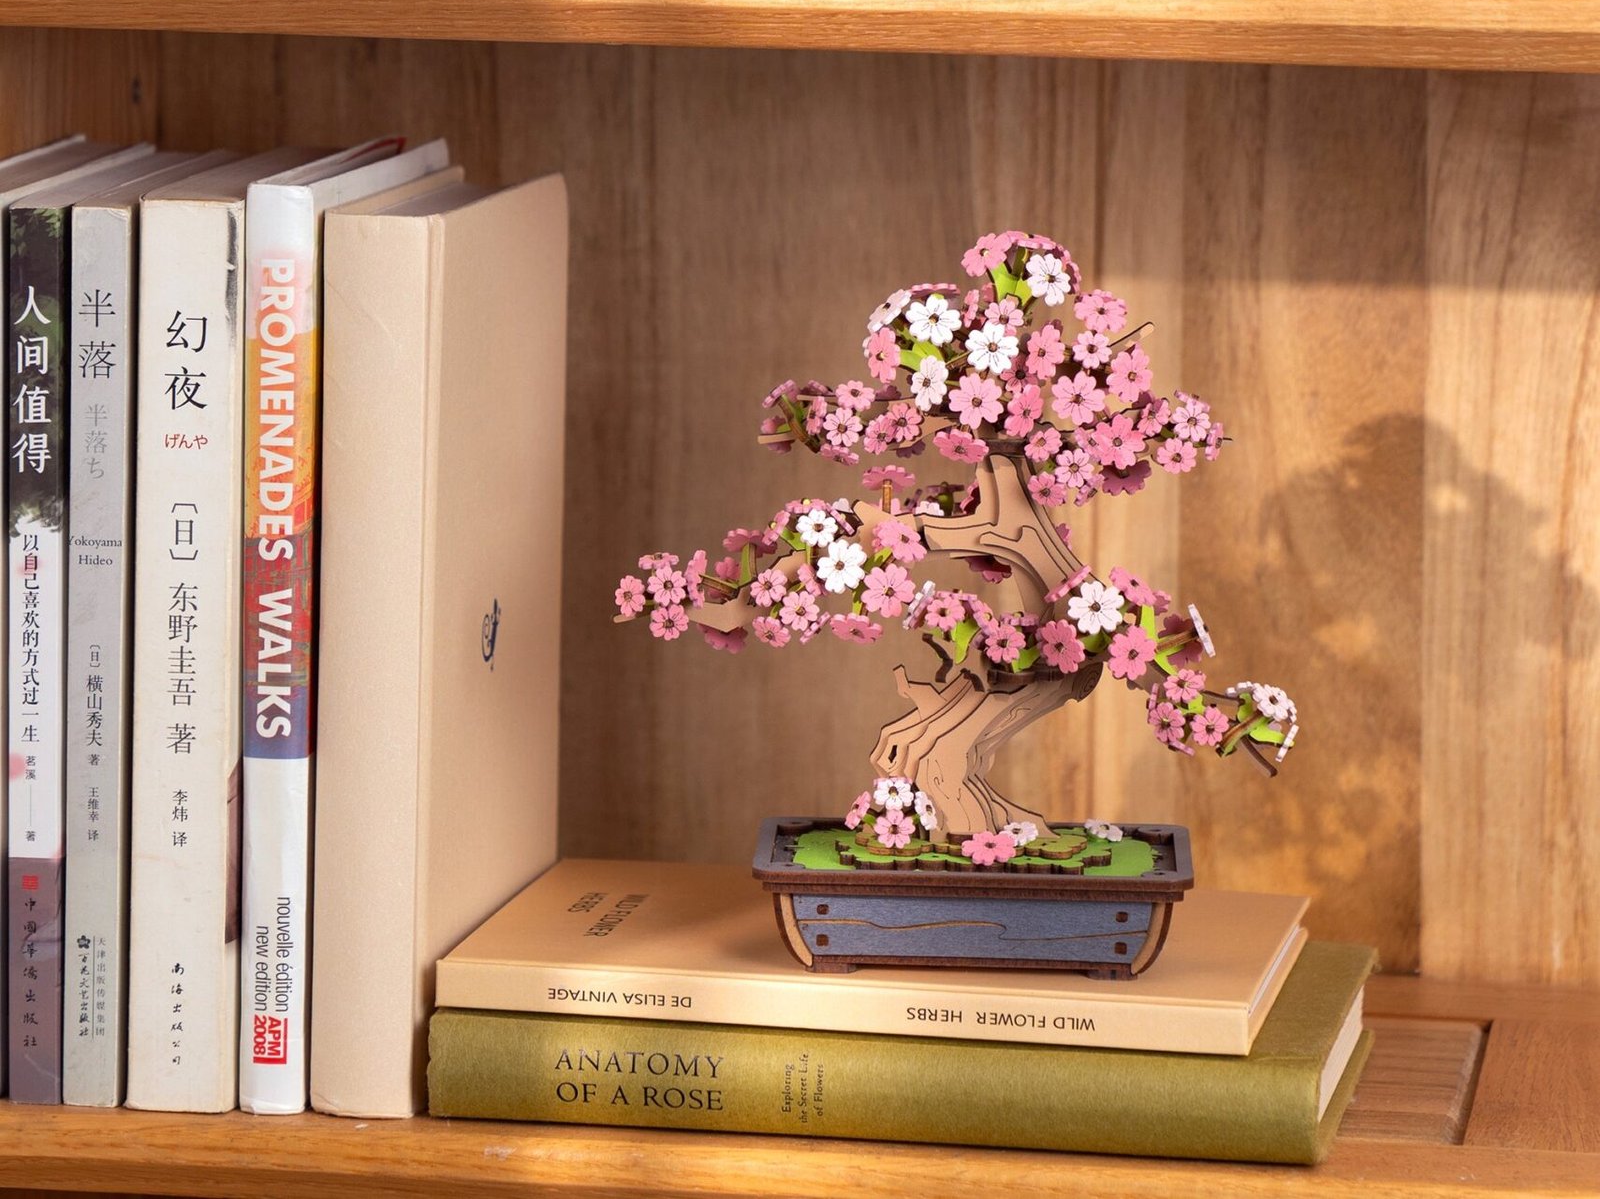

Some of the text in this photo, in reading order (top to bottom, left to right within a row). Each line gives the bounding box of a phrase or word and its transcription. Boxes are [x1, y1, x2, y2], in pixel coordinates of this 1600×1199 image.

[79, 289, 116, 379] 半落
[13, 286, 52, 473] 人间值得
[164, 310, 208, 410] 幻夜
[85, 404, 108, 479] 半落ち
[164, 433, 208, 450] げんや
[256, 259, 296, 738] PROMENADES WALKS
[67, 536, 122, 549] Yokoyama
[78, 554, 113, 566] Hideo
[21, 534, 40, 742] 以自己喜欢的方式过一生
[25, 755, 37, 780] 茗溪
[172, 790, 188, 847] 李炜 译
[254, 926, 271, 1011] new edition
[275, 896, 293, 1012] nouvelle édition
[548, 988, 692, 1008] DE ELISA VINTAGE
[906, 1007, 1096, 1032] WILD FLOWER HERBS
[253, 1014, 267, 1055] 2008
[267, 1016, 281, 1056] APM
[554, 1048, 723, 1079] ANATOMY
[556, 1082, 723, 1112] OF A ROSE
[781, 1064, 795, 1113] Exploring
[813, 1064, 824, 1117] of Flowers
